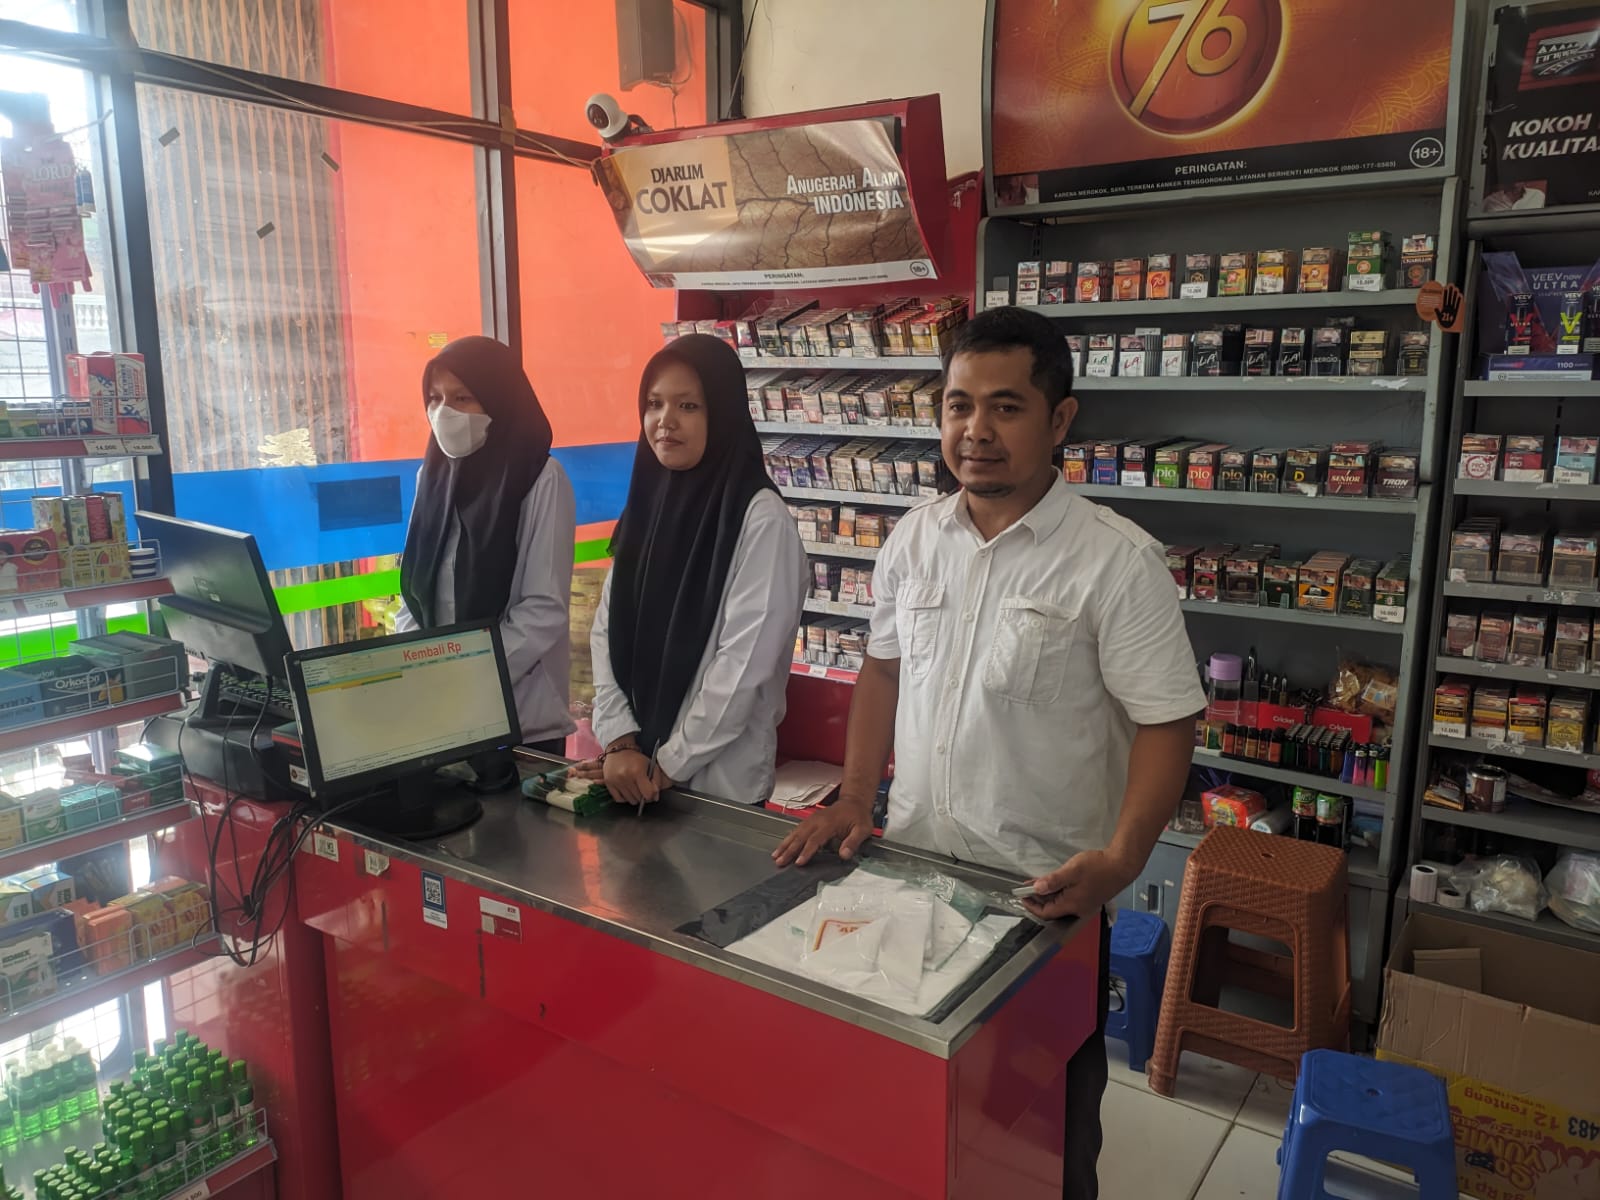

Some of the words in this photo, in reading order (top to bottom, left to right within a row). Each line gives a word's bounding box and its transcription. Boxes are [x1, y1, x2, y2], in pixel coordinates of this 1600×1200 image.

[1130, 0, 1247, 118] 76
[1508, 113, 1592, 138] KOKOH
[1414, 147, 1439, 159] 18+
[1502, 135, 1600, 161] KUALITA
[651, 164, 704, 184] DJARUM
[1175, 161, 1247, 175] PERINGATAN:
[1303, 166, 1338, 175] MEROKOK
[787, 173, 857, 195] ANUGERAH
[862, 167, 900, 188] ALAM
[635, 181, 728, 215] COKLAT
[814, 188, 904, 215] INDONESIA
[1533, 281, 1578, 290] ULTRA
[1331, 475, 1361, 483] SENIOR
[1382, 478, 1409, 487] TRON
[402, 645, 445, 663] Kembali
[447, 642, 462, 655] Rp
[1464, 1087, 1528, 1117] renteng
[1533, 1111, 1559, 1131] 12
